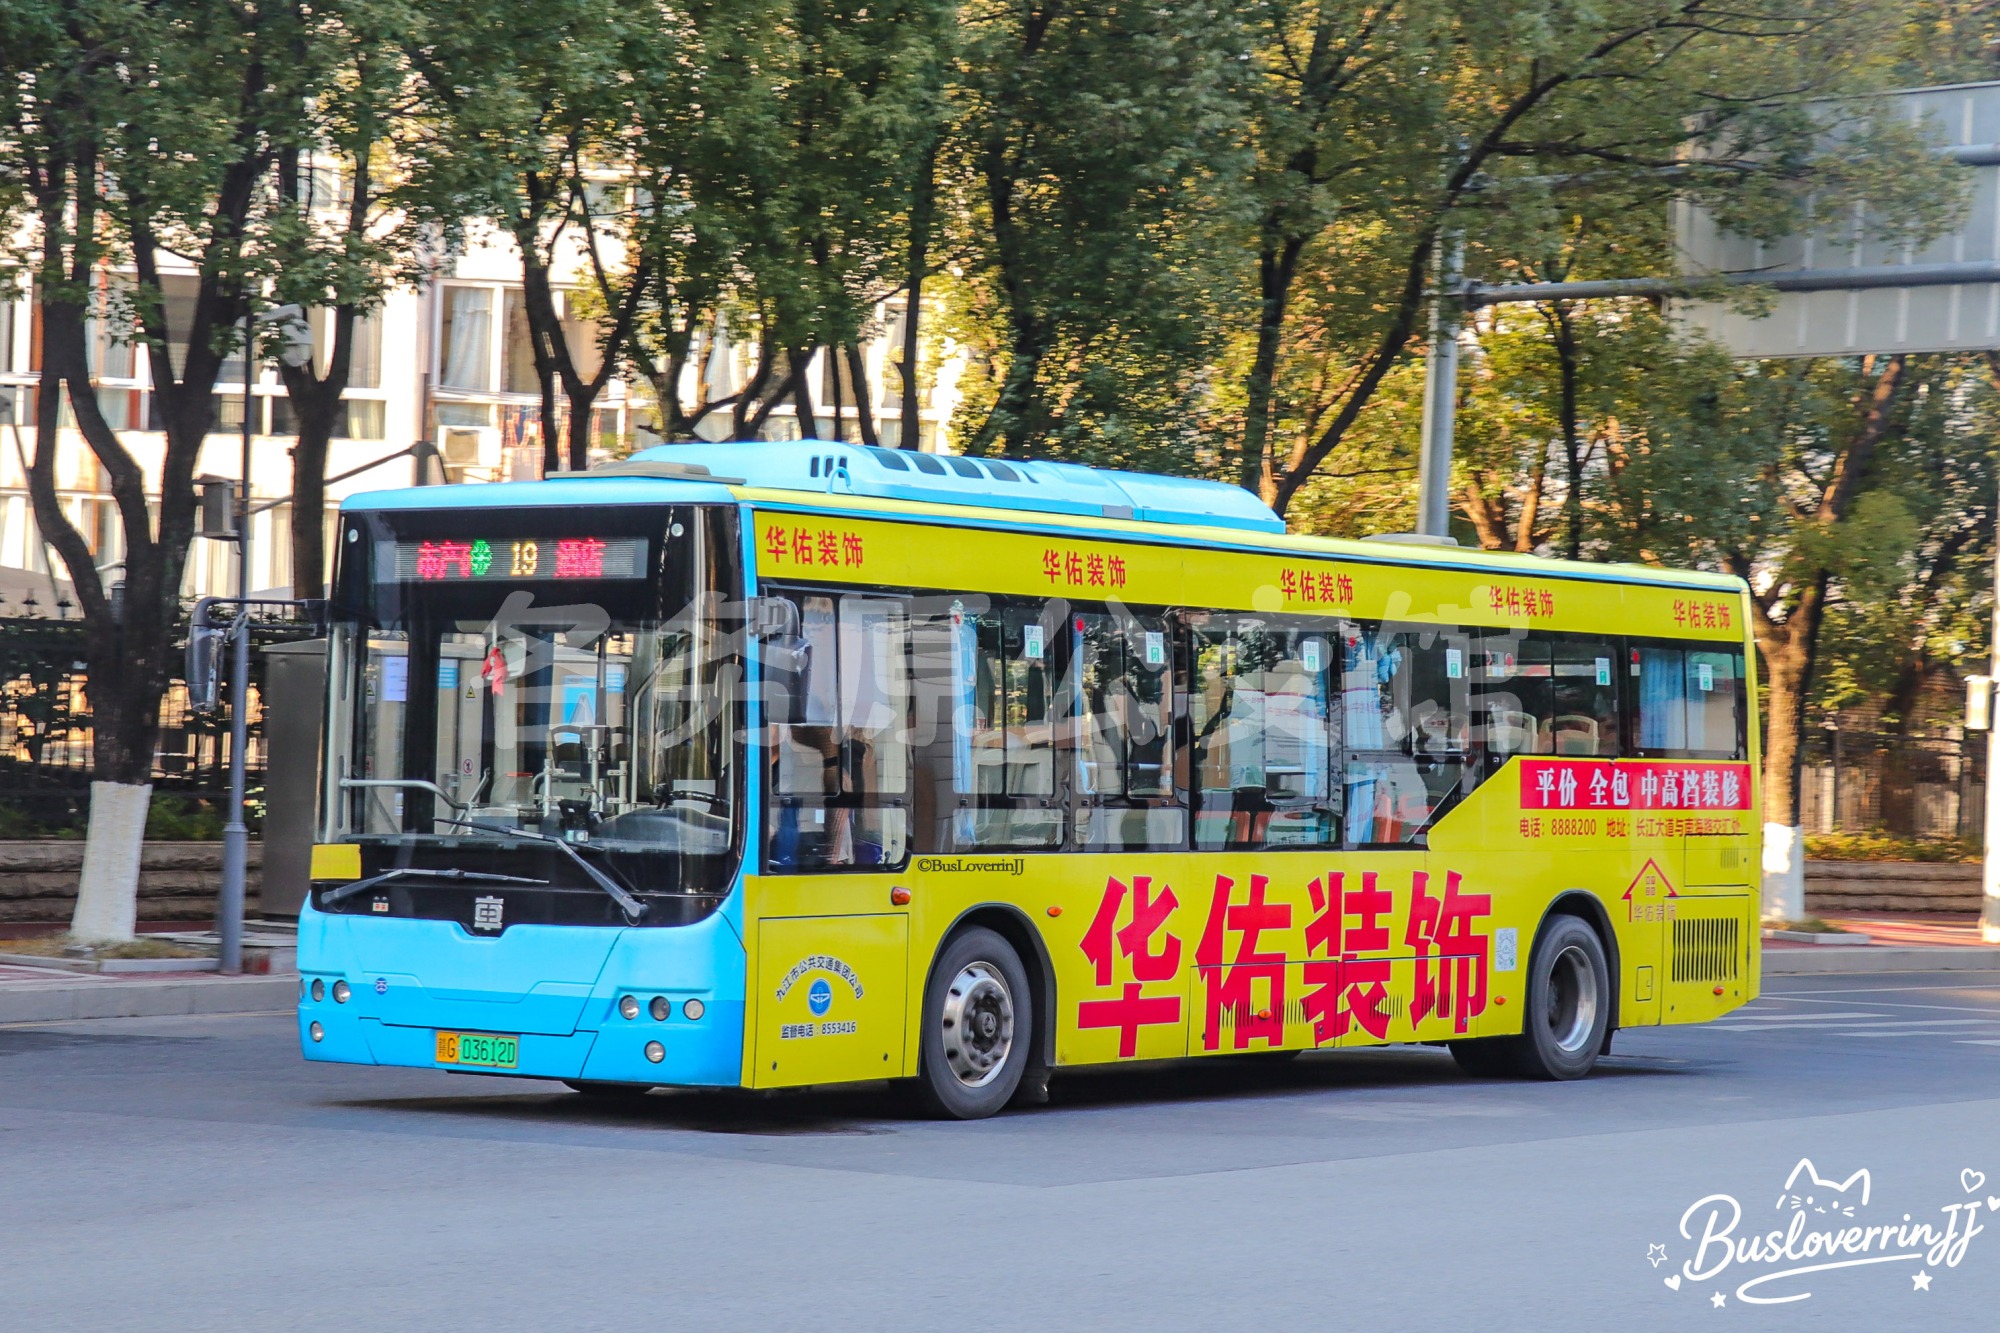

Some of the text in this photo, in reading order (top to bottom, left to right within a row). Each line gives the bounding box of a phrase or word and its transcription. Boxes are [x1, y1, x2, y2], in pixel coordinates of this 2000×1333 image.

[510, 541, 538, 577] 19
[765, 525, 864, 569] 华佑装饰
[1043, 549, 1127, 588] 华佑装饰
[1281, 568, 1354, 605] 华佑装饰
[1489, 585, 1554, 619] 华佑装饰
[1672, 599, 1731, 631] 华佑装饰
[1535, 767, 1741, 808] 平价 全包 中高档装修
[775, 955, 865, 1002] 九江市公共交通集团公司
[1077, 869, 1492, 1058] 华佑装饰
